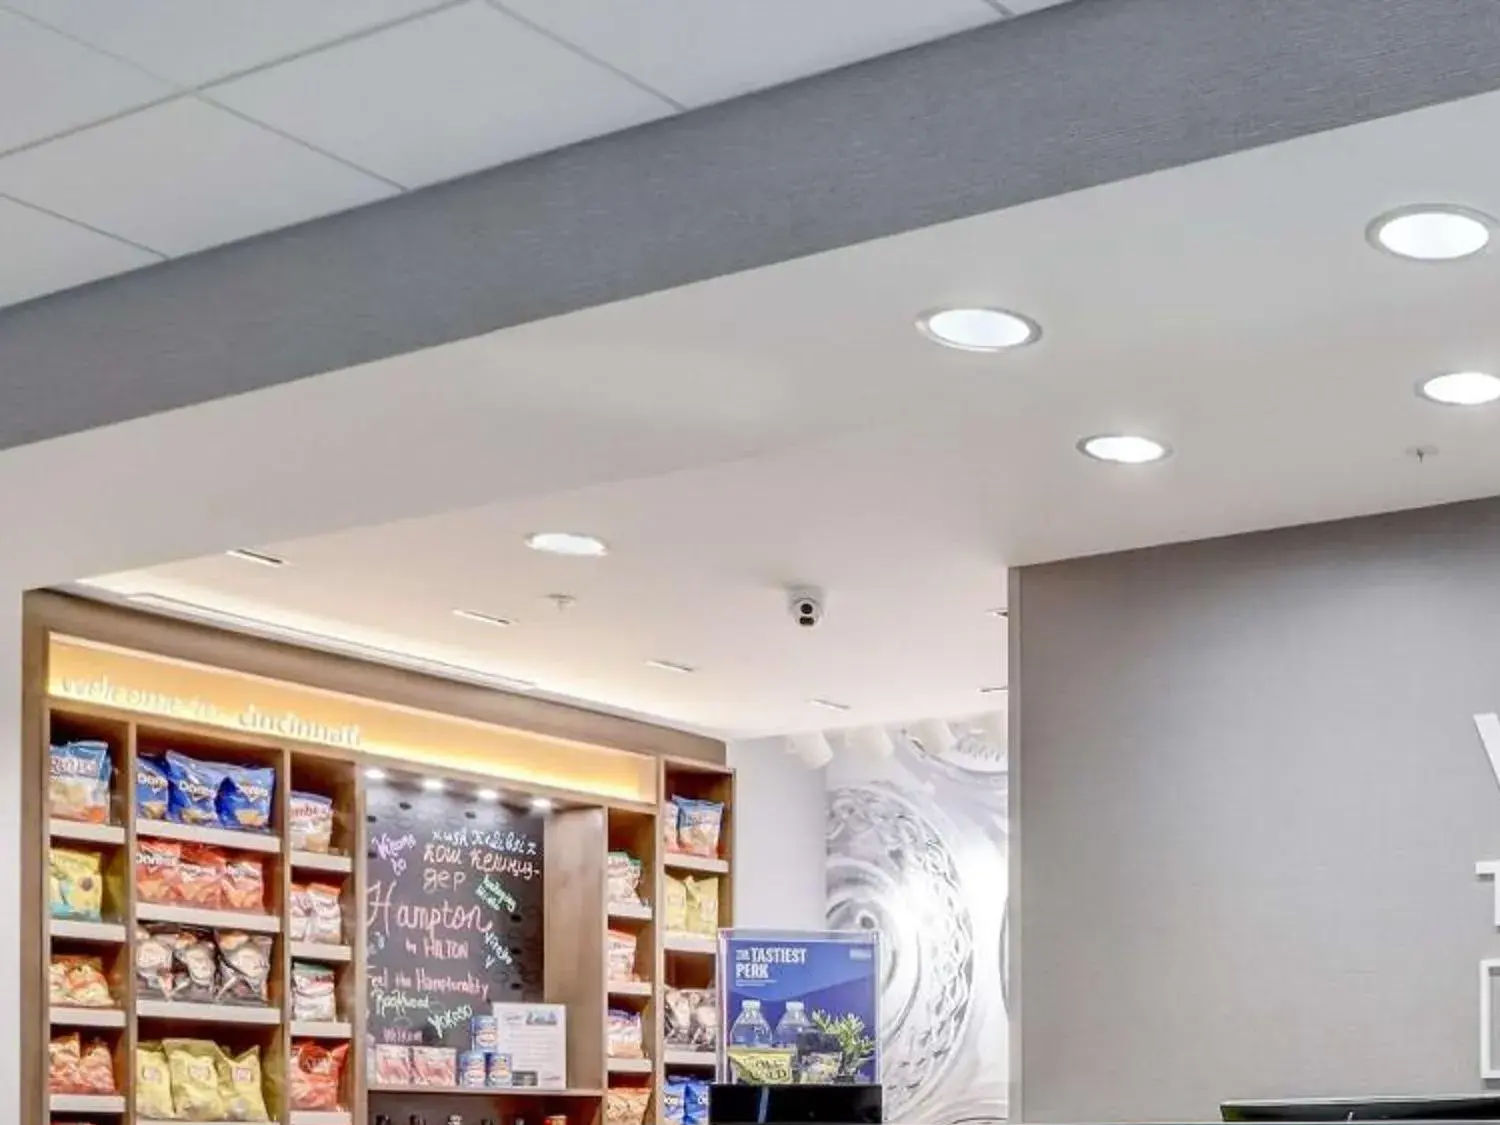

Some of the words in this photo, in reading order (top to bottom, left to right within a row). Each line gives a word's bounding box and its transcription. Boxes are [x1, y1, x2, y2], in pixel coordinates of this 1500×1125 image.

[366, 880, 494, 941] Hampton
[751, 947, 808, 965] TASTIEST
[736, 963, 769, 979] PERK
